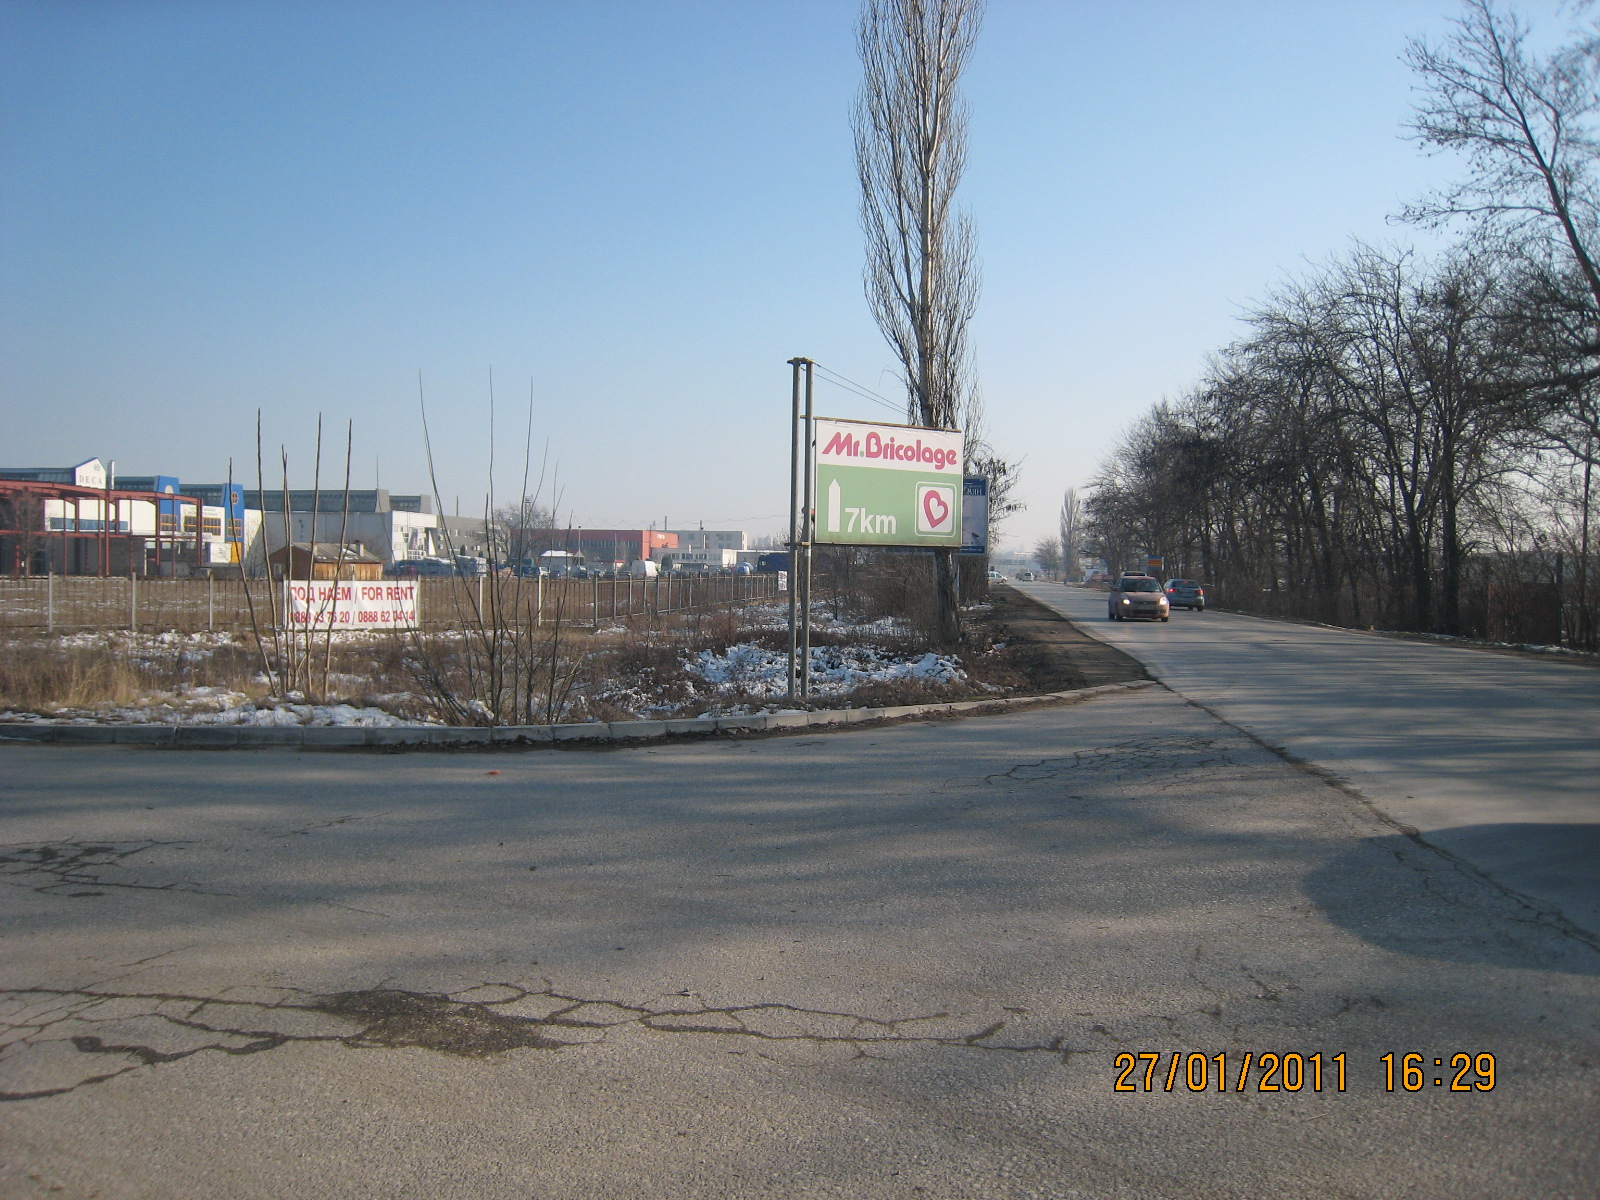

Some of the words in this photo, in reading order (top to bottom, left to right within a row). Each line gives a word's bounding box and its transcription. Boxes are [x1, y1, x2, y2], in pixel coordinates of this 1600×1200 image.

[79, 475, 102, 485] DECA
[844, 507, 897, 535] 7km
[291, 586, 316, 603] ПОД
[318, 586, 352, 600] НАЕМ
[361, 586, 384, 600] FOR
[386, 586, 414, 600] RENT
[340, 611, 350, 623] 20
[358, 611, 378, 623] 0888
[381, 611, 390, 623] 62
